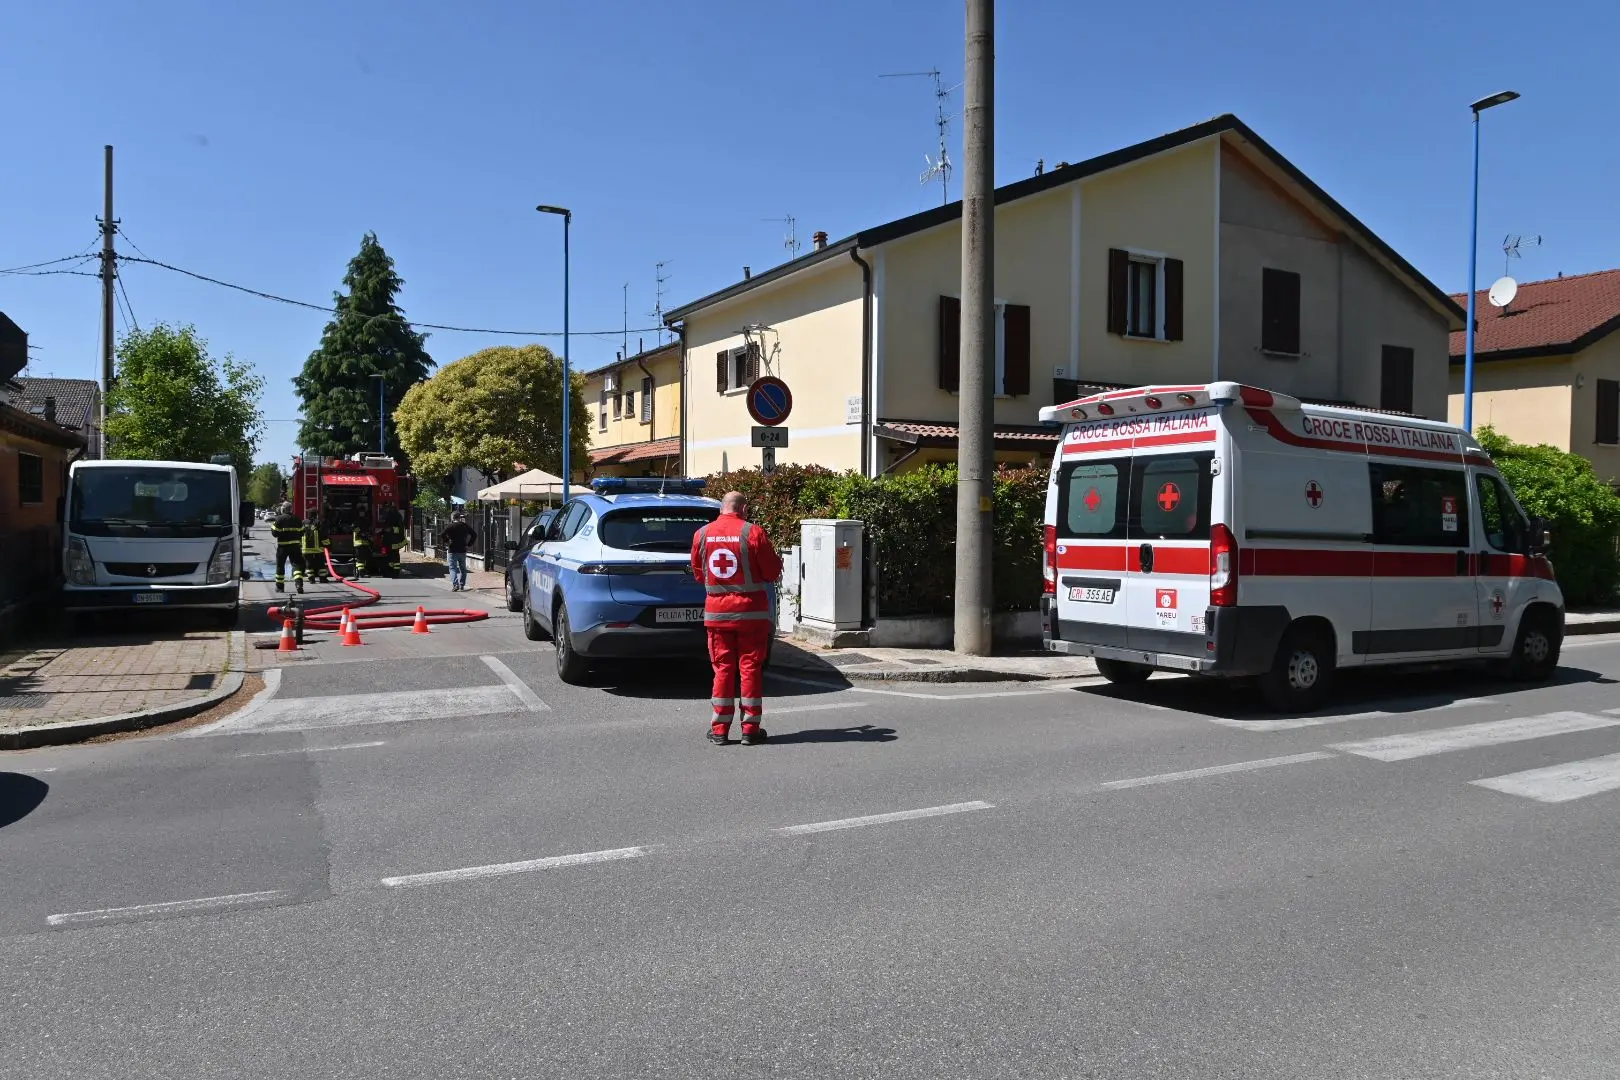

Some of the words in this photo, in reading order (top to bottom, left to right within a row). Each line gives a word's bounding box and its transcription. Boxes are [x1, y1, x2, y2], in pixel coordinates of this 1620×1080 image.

[1072, 423, 1109, 440] CROCE
[1111, 419, 1151, 436] ROSSA
[1153, 411, 1208, 432] ITALIANA
[760, 431, 780, 442] 0-24
[1303, 416, 1352, 439] CROCE
[1353, 423, 1400, 444] ROSSA
[1401, 428, 1455, 450] ITALIANA
[1071, 588, 1083, 599] CRI
[1101, 589, 1112, 601] AE
[1160, 611, 1177, 619] AREU
